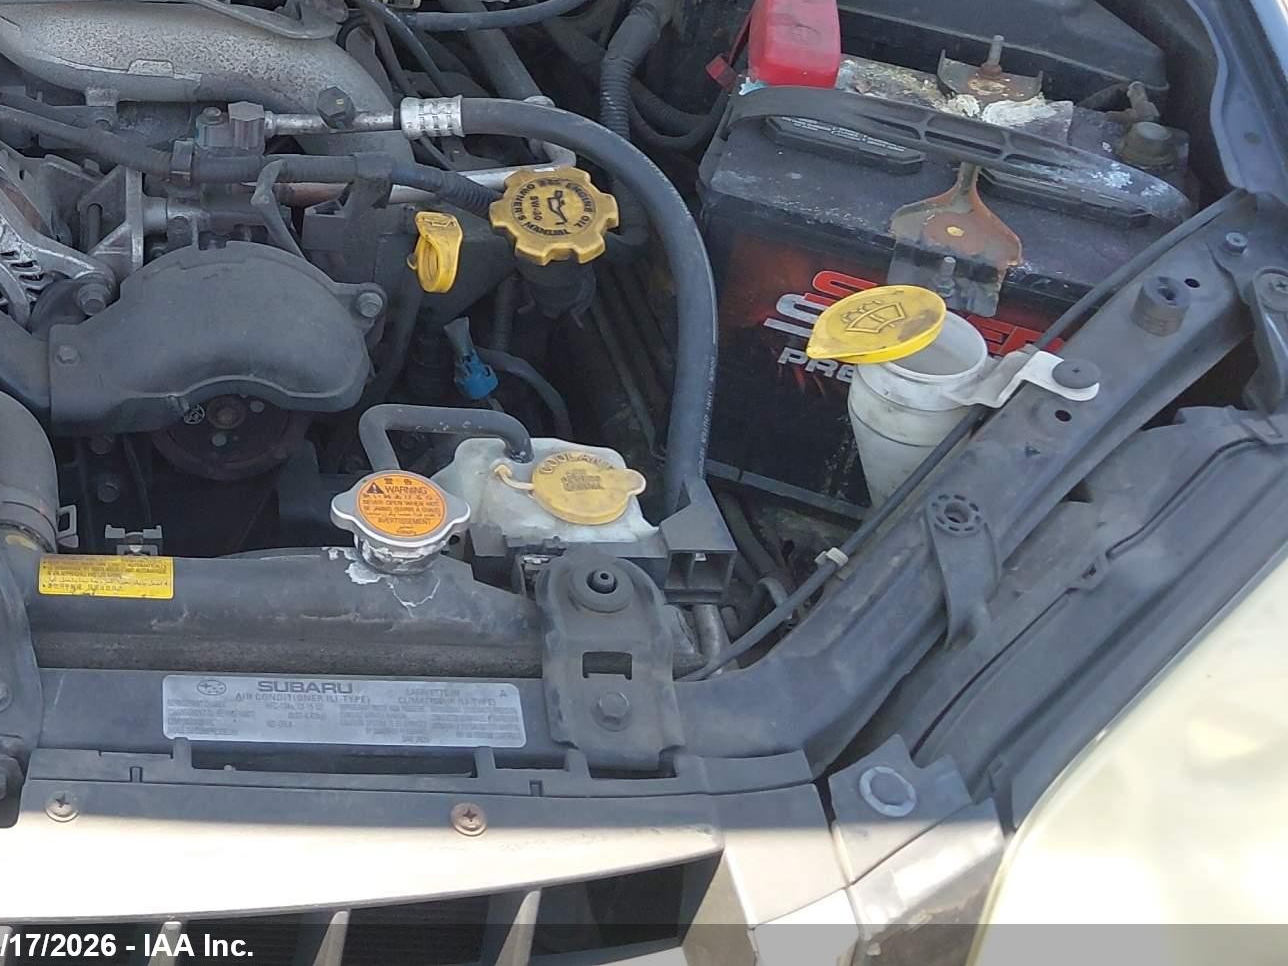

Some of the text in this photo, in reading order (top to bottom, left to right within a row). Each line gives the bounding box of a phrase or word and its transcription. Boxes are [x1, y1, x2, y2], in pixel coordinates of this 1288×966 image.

[574, 216, 592, 228] OIL
[385, 485, 428, 495] WARNING
[258, 680, 353, 694] SUBARU
[234, 692, 254, 701] AIR
[255, 693, 324, 702] CONDITIONER
